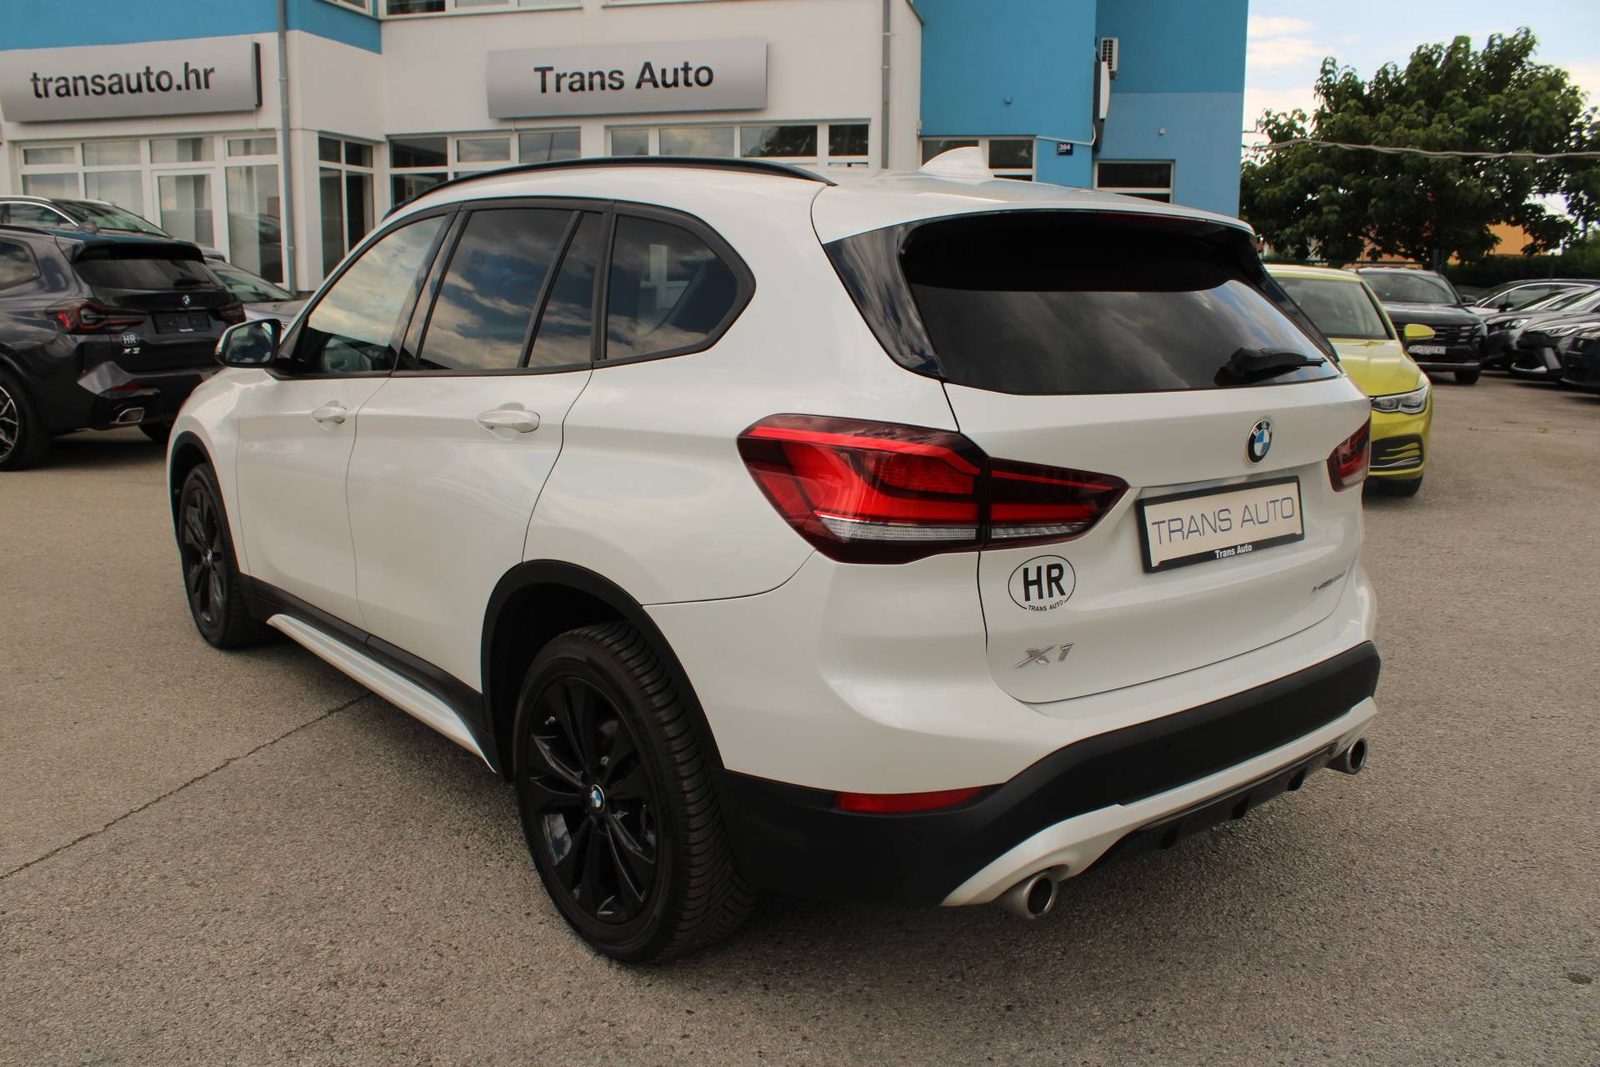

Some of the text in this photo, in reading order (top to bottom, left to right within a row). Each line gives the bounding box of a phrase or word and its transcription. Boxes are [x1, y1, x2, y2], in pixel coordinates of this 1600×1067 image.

[31, 62, 215, 99] transauto.hr
[534, 61, 714, 93] Trans Auto
[122, 334, 137, 345] HR
[1151, 496, 1295, 545] TRANS AUTO
[1214, 543, 1253, 559] Trans Auto
[1022, 563, 1066, 602] HR
[1028, 600, 1064, 612] TRANS AUTO
[1013, 642, 1075, 669] X1
